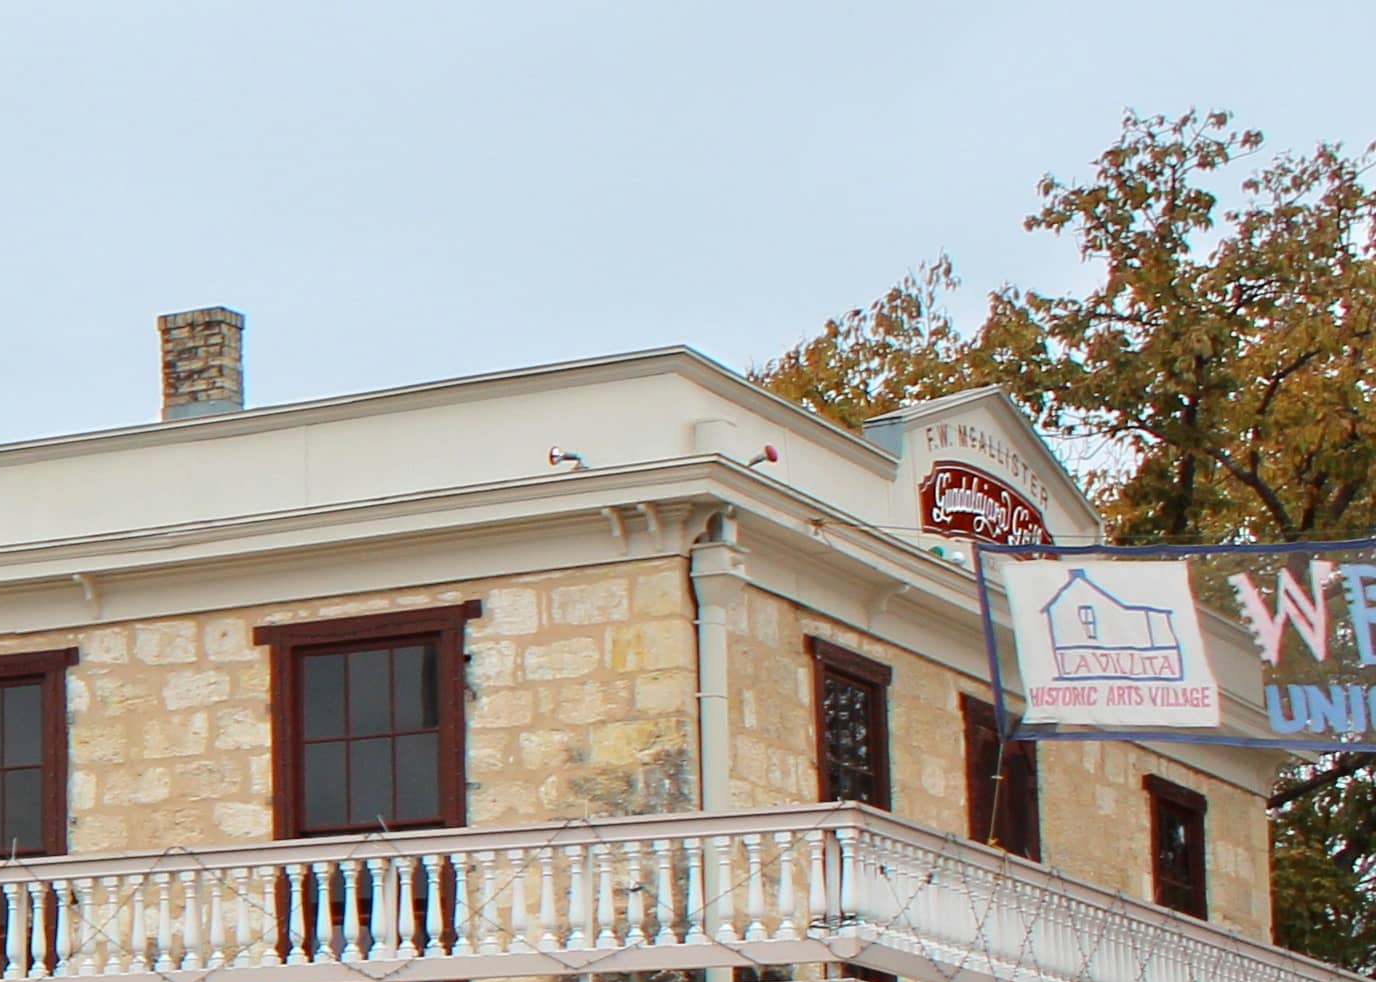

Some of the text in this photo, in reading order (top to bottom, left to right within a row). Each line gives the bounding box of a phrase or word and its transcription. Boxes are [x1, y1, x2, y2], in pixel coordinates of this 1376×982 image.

[932, 472, 1012, 537] Guadalajara
[1029, 685, 1211, 709] HISTORIC ARTS VILLAGE
[1264, 683, 1376, 734] UNI
